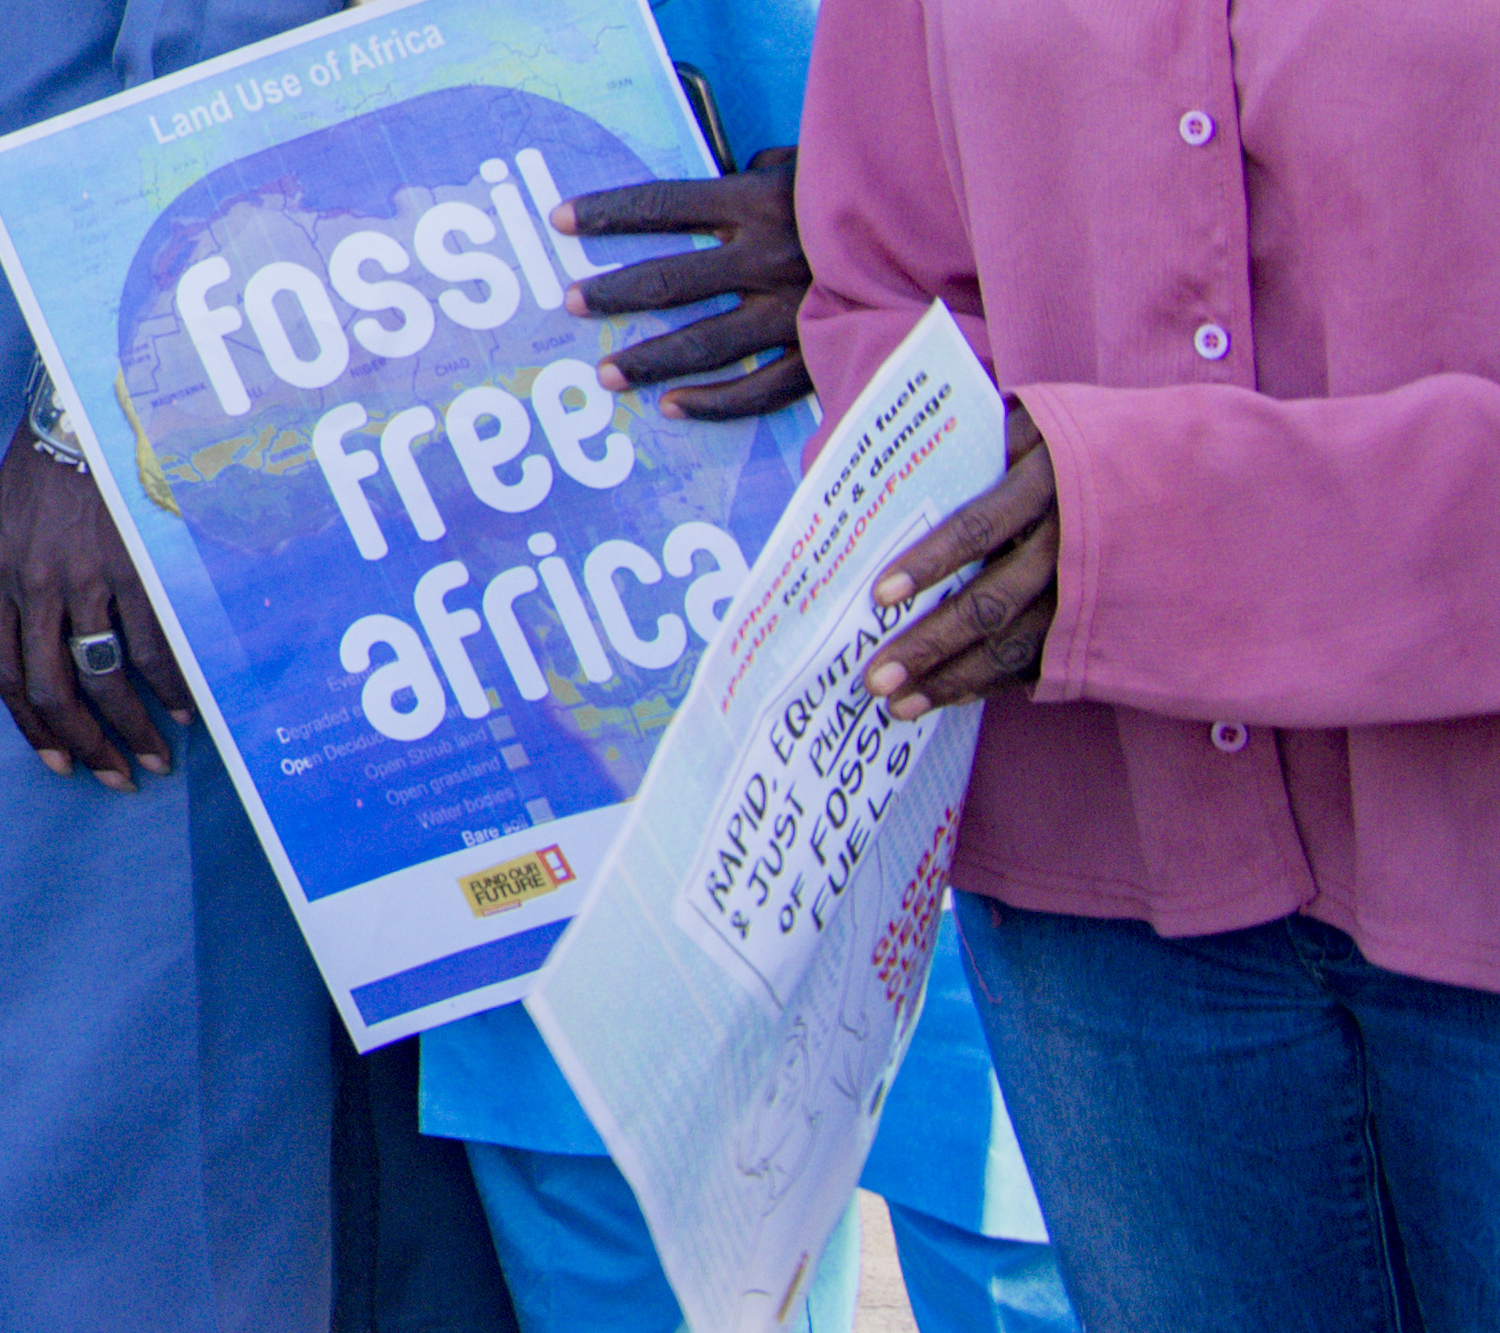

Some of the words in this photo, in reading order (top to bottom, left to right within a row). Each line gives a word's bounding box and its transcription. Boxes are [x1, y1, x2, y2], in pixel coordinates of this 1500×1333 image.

[148, 93, 234, 145] Land
[235, 68, 303, 113] Use
[308, 50, 343, 88] of
[349, 23, 447, 75] Africa
[173, 145, 624, 417] fossil
[433, 357, 472, 377] CHAD
[531, 333, 578, 355] SUDAN
[311, 357, 637, 562] free
[822, 432, 873, 508] fossil
[875, 370, 929, 432] fuels
[782, 568, 810, 606] for
[812, 509, 849, 565] loss
[869, 382, 954, 478] damage
[338, 520, 758, 743] africa
[276, 707, 348, 744] Degraded
[364, 757, 406, 780] Open
[385, 785, 428, 806] Open
[428, 756, 499, 796] grassland
[460, 824, 500, 848] Bare
[747, 782, 806, 907] JUST
[473, 874, 546, 906] FUTURE
[508, 861, 542, 880] OUR
[779, 873, 806, 934] OF
